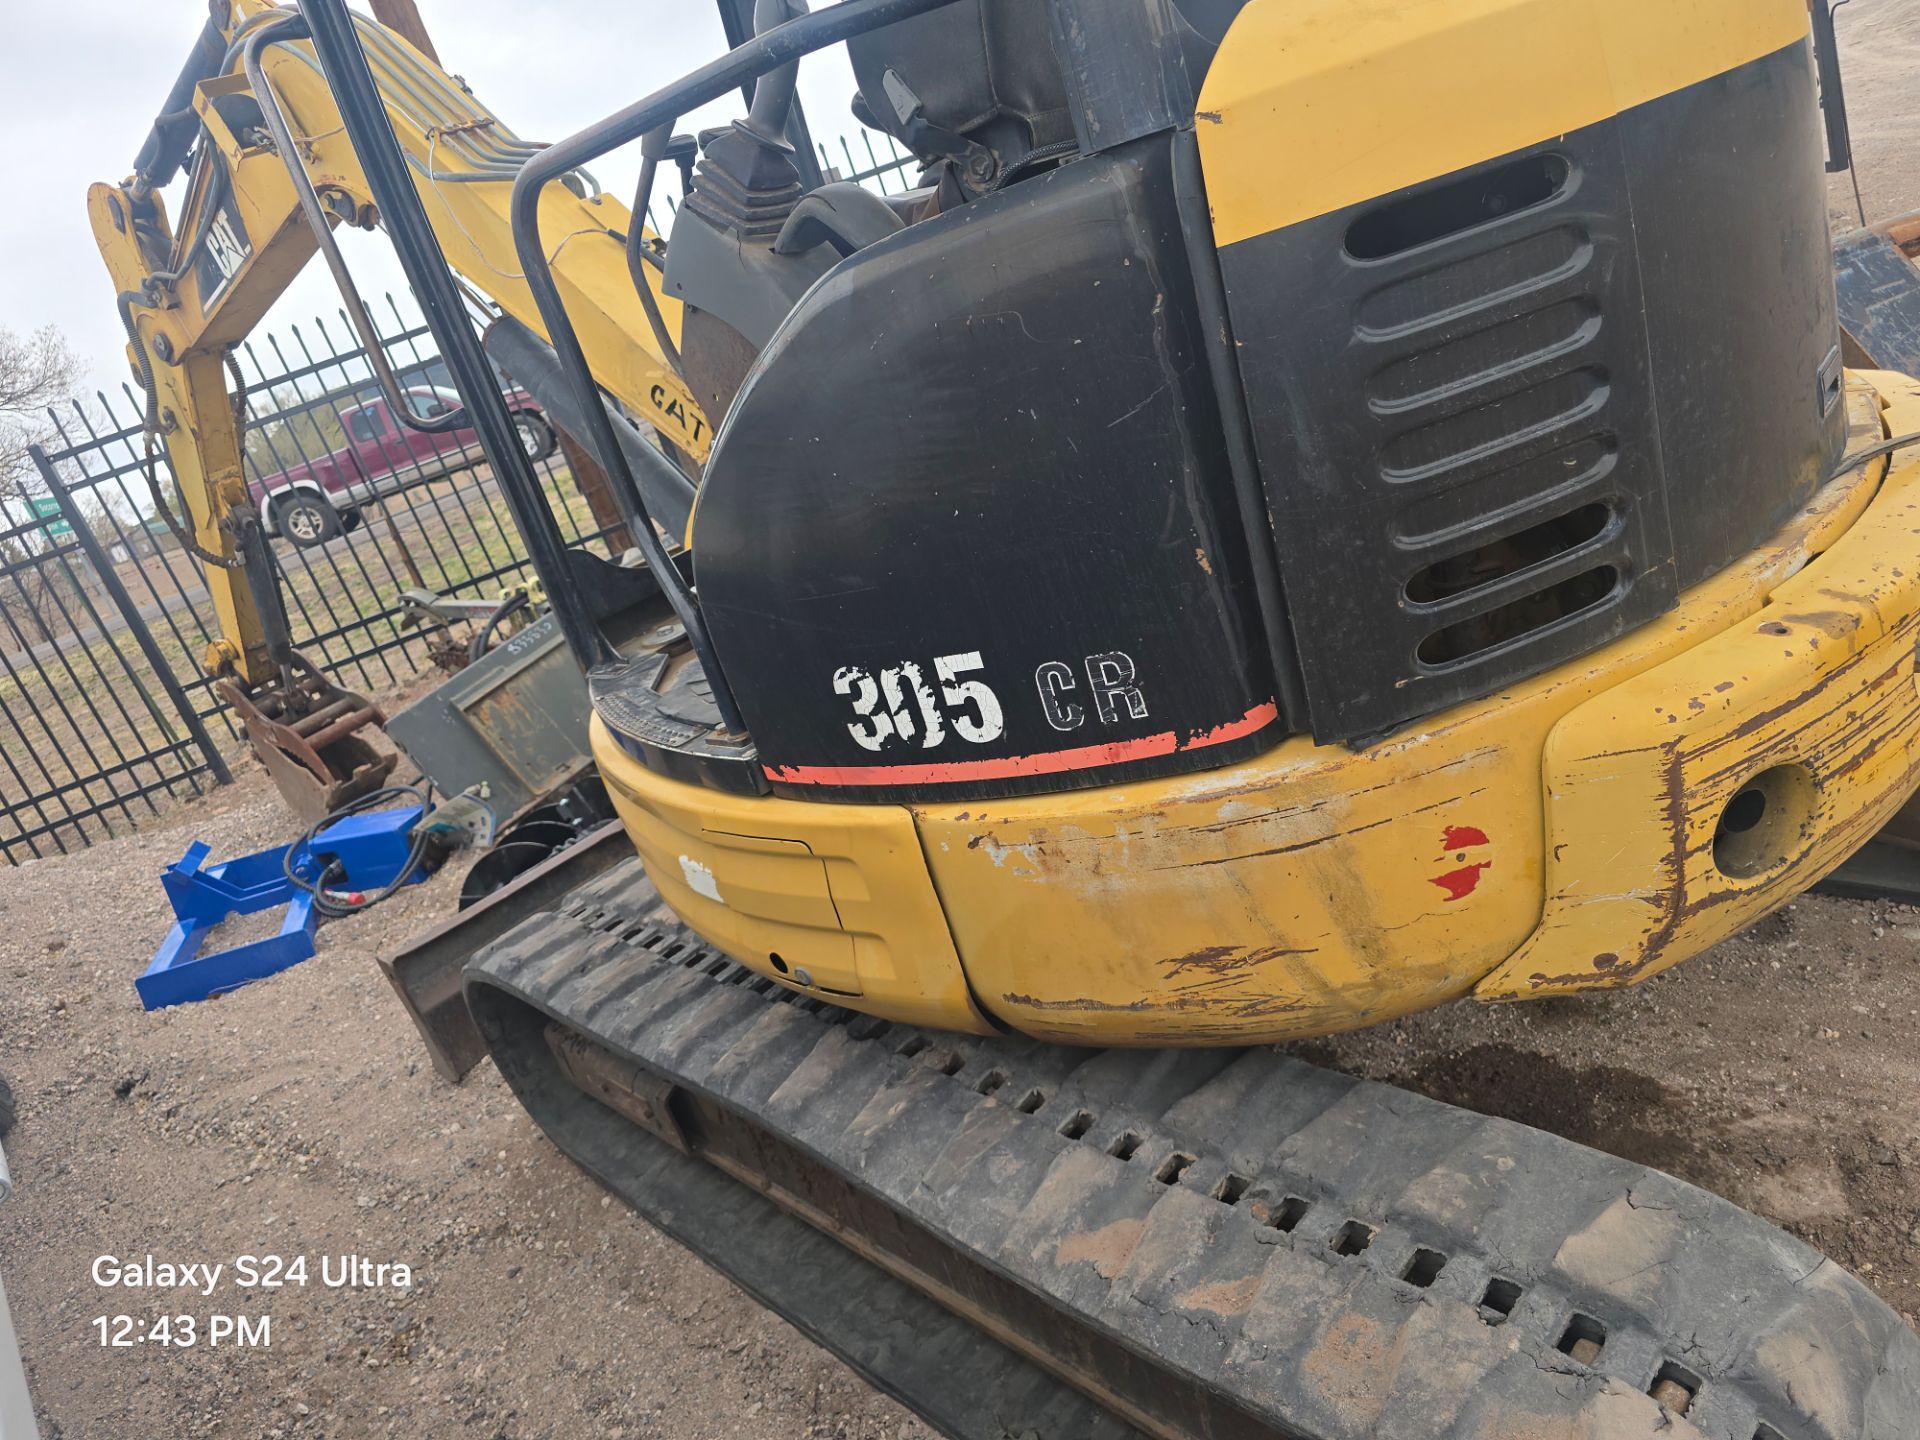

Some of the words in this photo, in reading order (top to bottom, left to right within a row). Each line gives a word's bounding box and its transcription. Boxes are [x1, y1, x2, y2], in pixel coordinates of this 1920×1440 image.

[205, 208, 247, 279] CAT
[650, 384, 705, 442] CAT
[832, 650, 1004, 752] 305
[1036, 651, 1149, 732] CR
